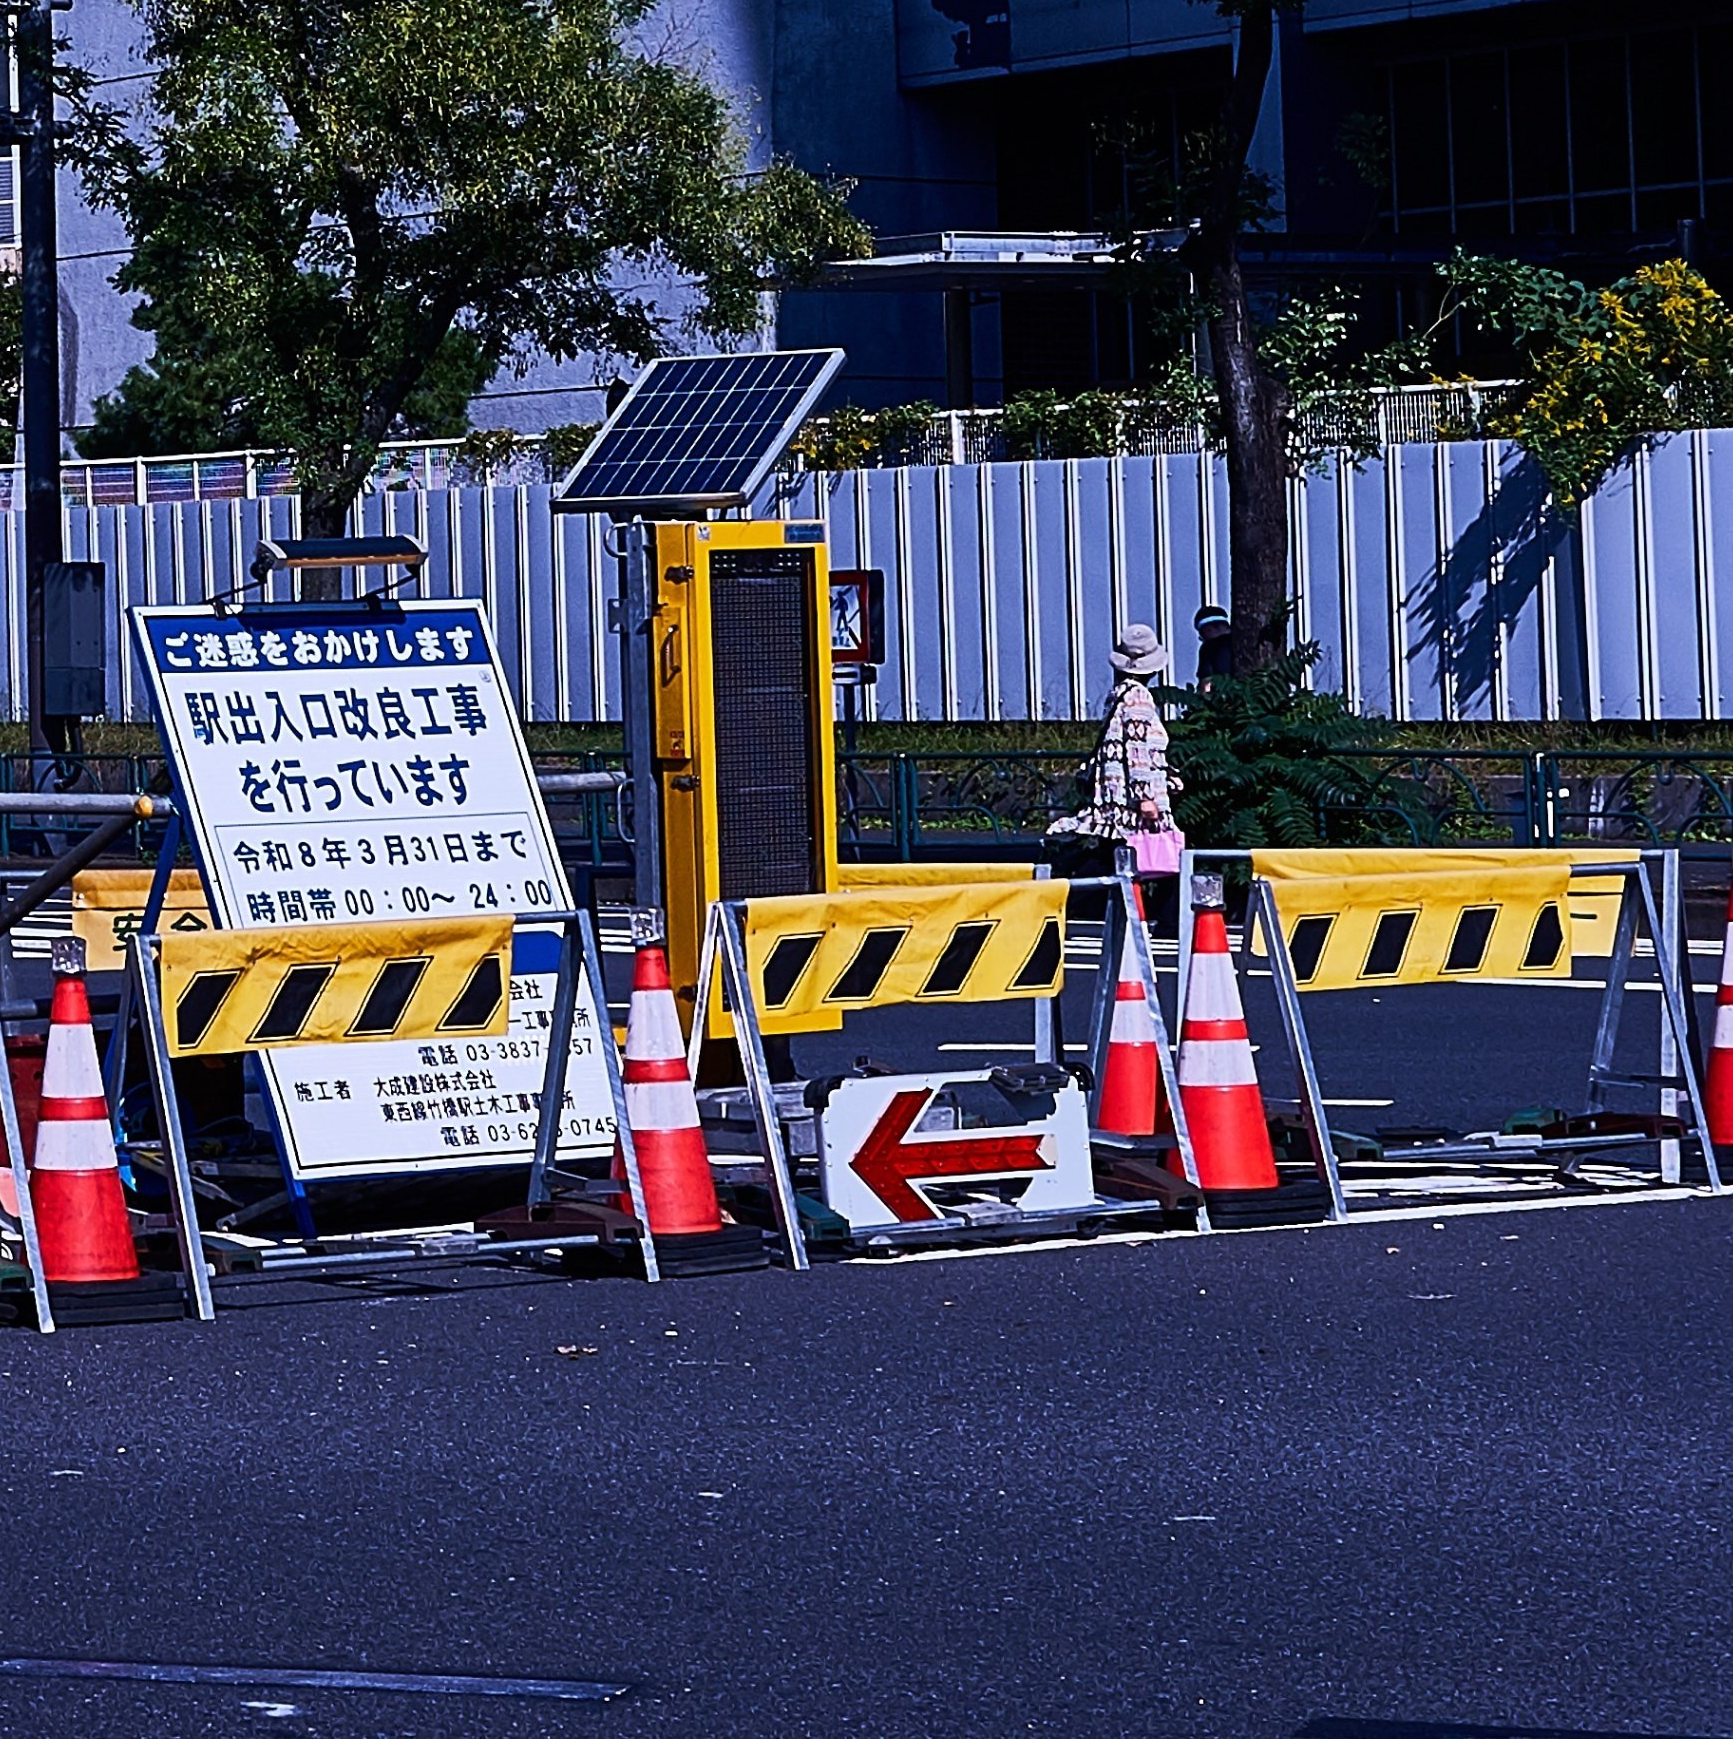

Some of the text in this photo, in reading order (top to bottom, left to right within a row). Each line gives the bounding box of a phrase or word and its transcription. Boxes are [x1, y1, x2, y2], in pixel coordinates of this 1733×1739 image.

[164, 625, 475, 669] ご迷惑をおかけします
[183, 683, 489, 746] 駅出入口改良工事
[238, 752, 471, 814] を行っています
[233, 829, 528, 874] 令和8年3月31日まで
[246, 887, 335, 923] 時間帯
[418, 1045, 459, 1067] 電話
[294, 1069, 497, 1102] 施工者 大成建設株式会社
[440, 1124, 481, 1147] 電話
